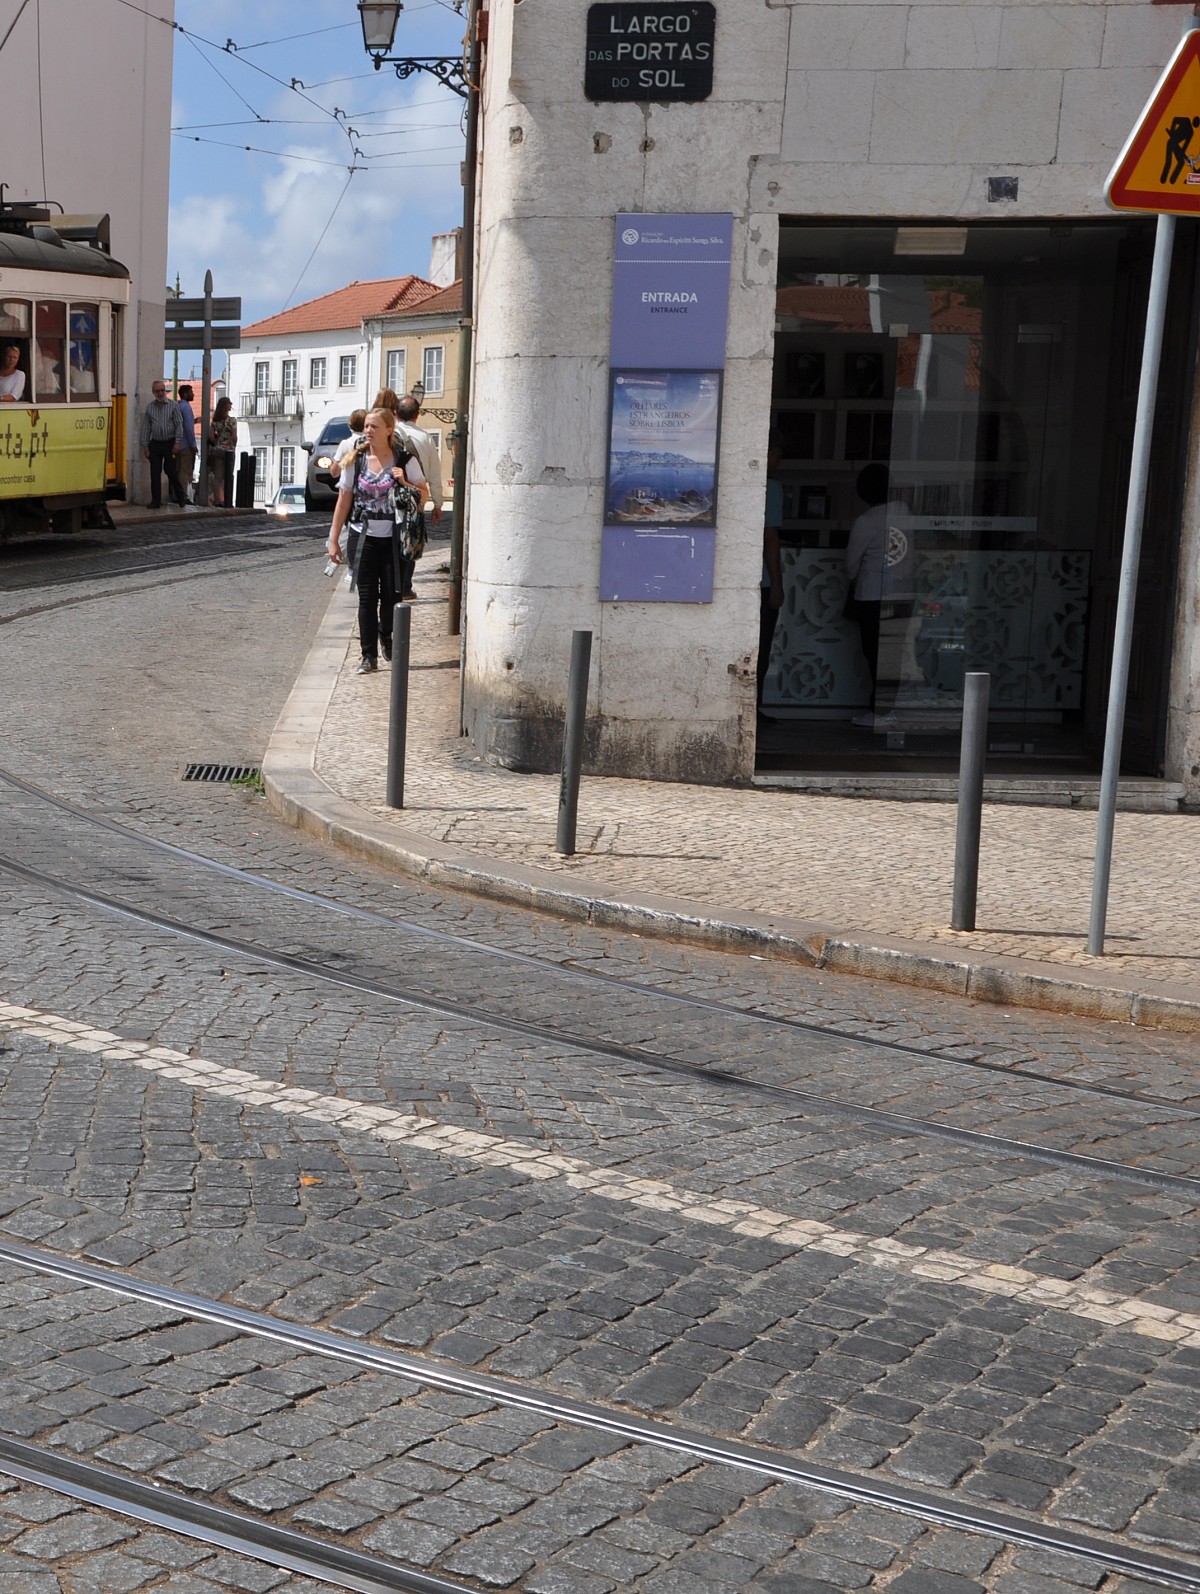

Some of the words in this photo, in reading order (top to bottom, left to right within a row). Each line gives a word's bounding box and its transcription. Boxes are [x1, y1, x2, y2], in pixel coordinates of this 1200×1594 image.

[610, 15, 691, 34] LARGO
[589, 50, 613, 61] DAS
[617, 42, 711, 61] PORTAS
[612, 77, 630, 88] DO
[638, 69, 686, 88] SOL
[641, 292, 699, 303] ENTRADA
[650, 306, 689, 314] ENTRANCE
[23, 474, 36, 483] casa
